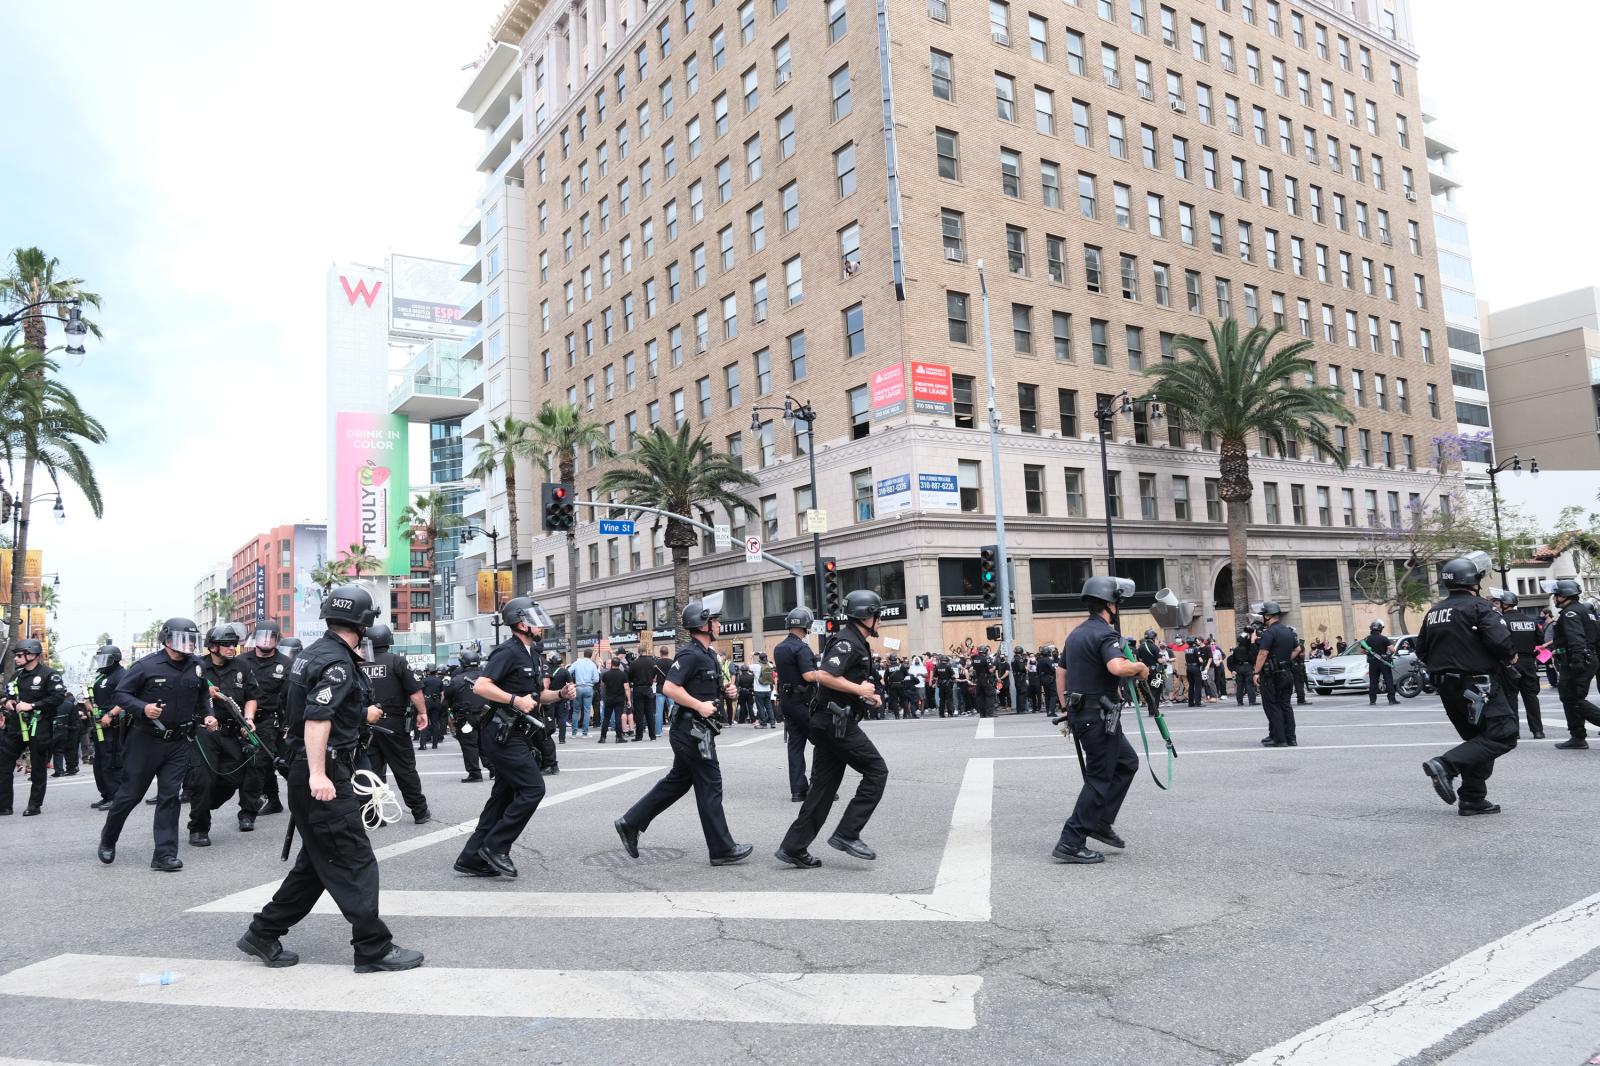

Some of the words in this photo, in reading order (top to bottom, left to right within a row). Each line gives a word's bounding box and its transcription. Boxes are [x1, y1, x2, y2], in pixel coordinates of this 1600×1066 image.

[339, 275, 383, 308] W
[885, 389, 902, 399] LEASE
[345, 429, 383, 439] DRINK
[388, 430, 400, 439] IN
[353, 440, 394, 449] COLOR
[362, 487, 377, 548] TRULY
[603, 523, 619, 532] Vine
[622, 524, 630, 532] St
[331, 598, 353, 609] 34372
[947, 604, 988, 612] STARBUCK
[1427, 608, 1453, 625] POLICE
[1513, 622, 1533, 630] POLICE
[409, 655, 432, 664] BLACK
[325, 666, 333, 675] LOS
[334, 665, 347, 681] ANGELES
[362, 666, 384, 676] OLICE
